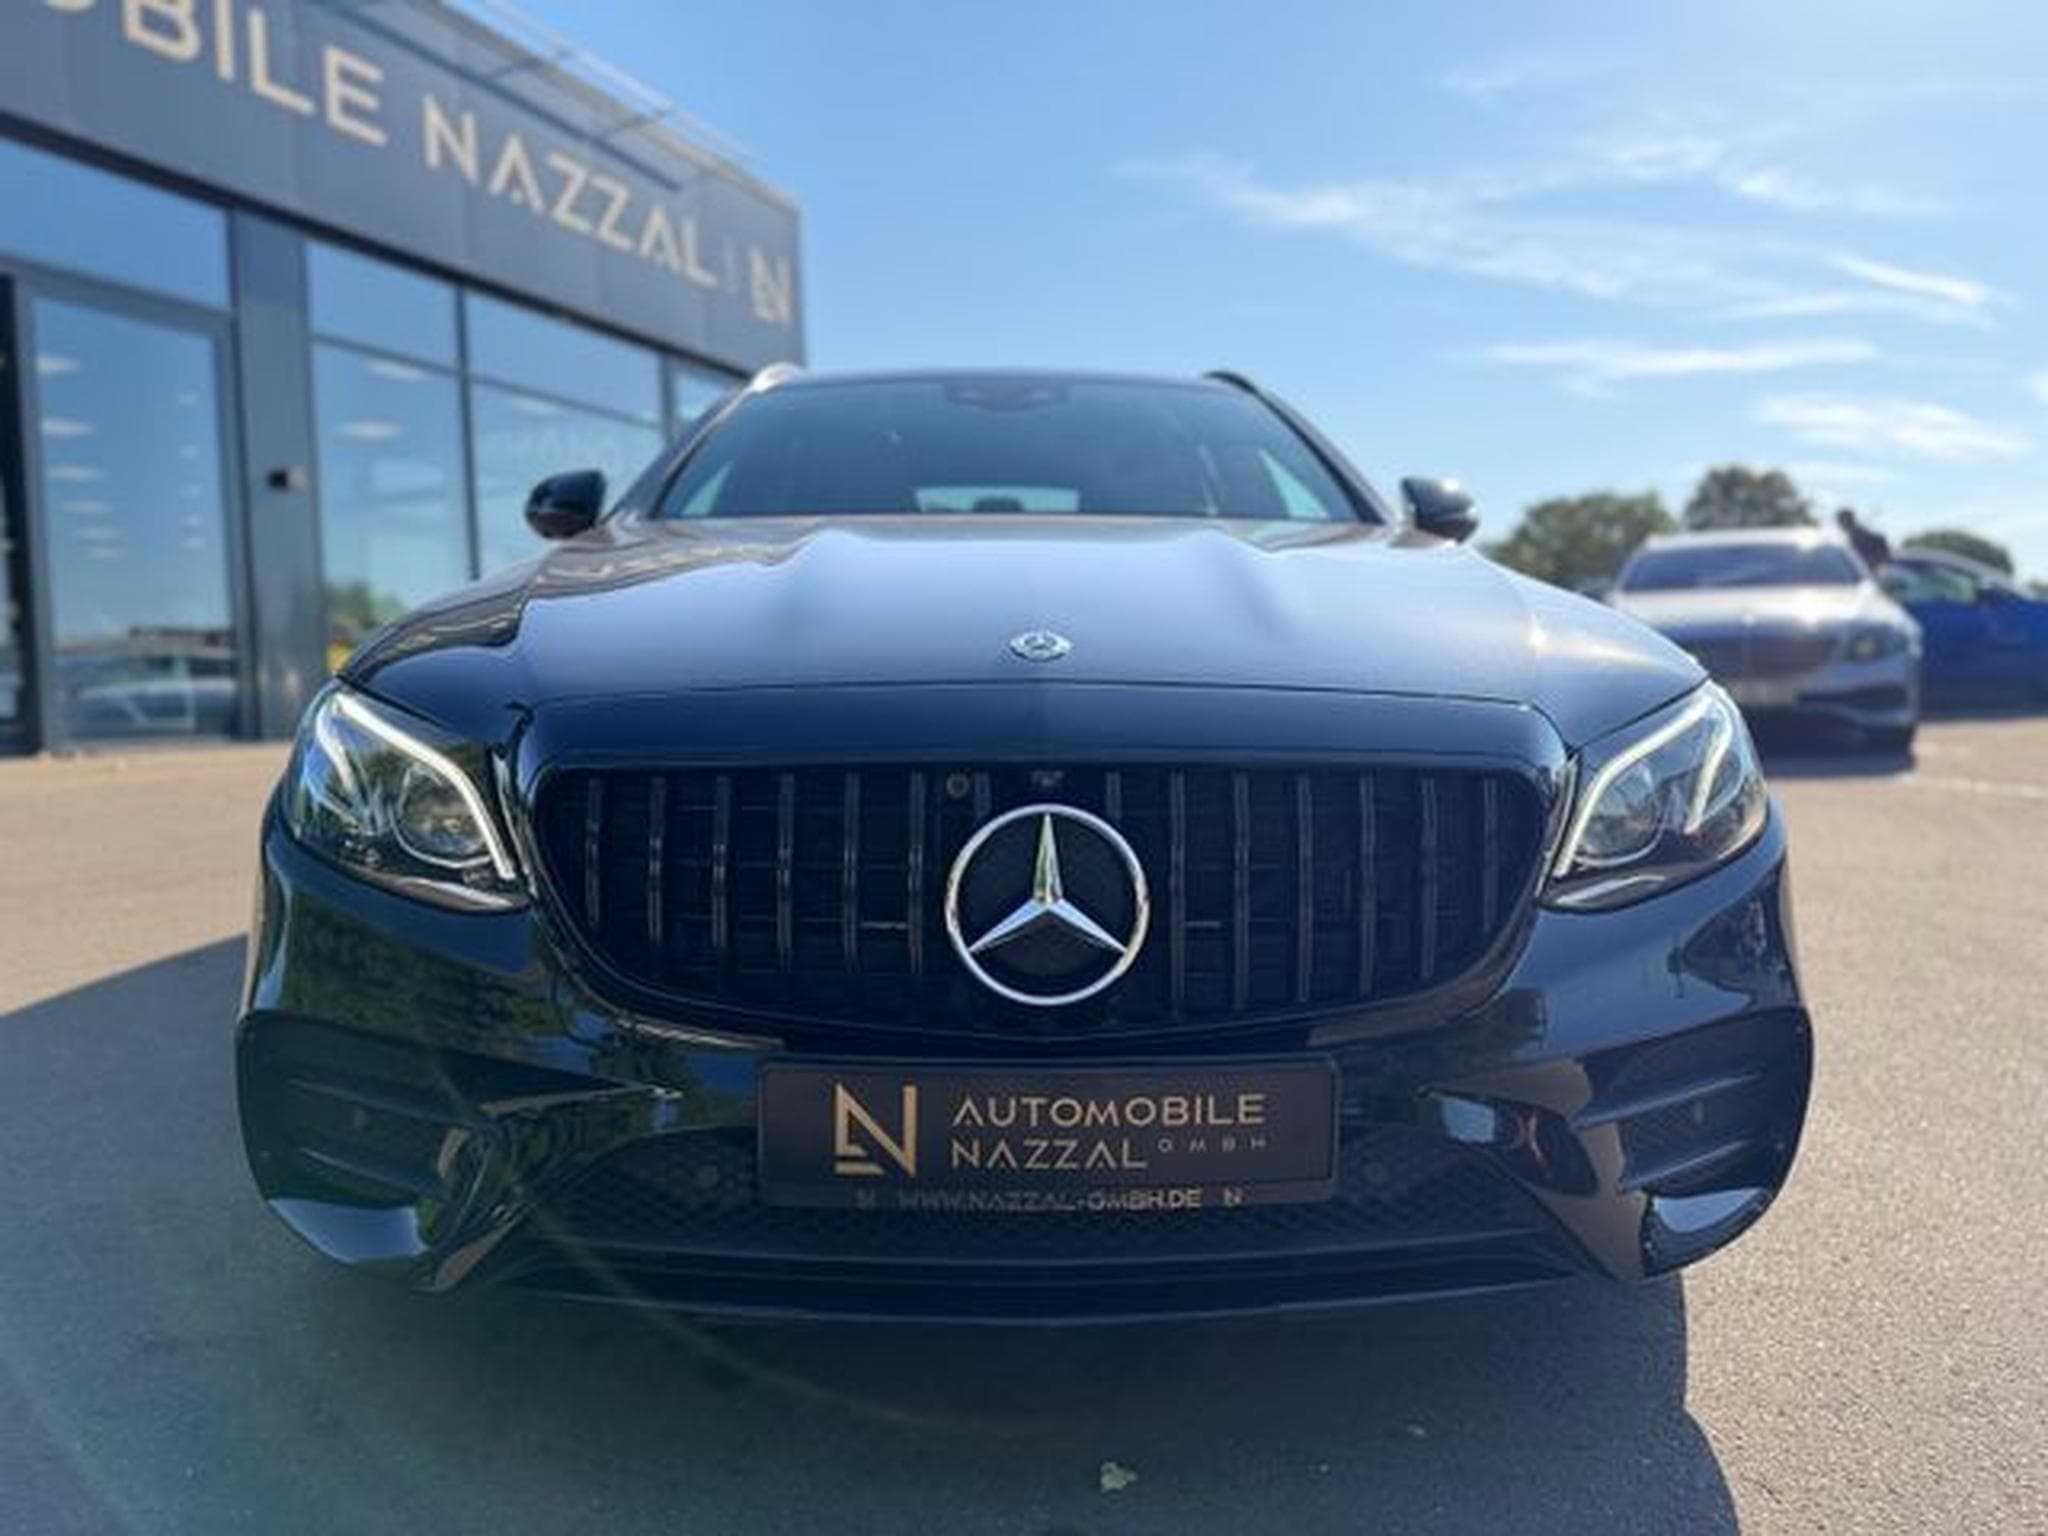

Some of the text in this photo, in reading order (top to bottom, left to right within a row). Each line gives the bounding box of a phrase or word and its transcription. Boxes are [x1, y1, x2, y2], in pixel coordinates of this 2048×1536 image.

[42, 0, 389, 147] BILE
[421, 93, 721, 289] NAZZAL
[951, 1093, 1267, 1128] AUTOMOBILE
[951, 1137, 1148, 1170] NAZZAL
